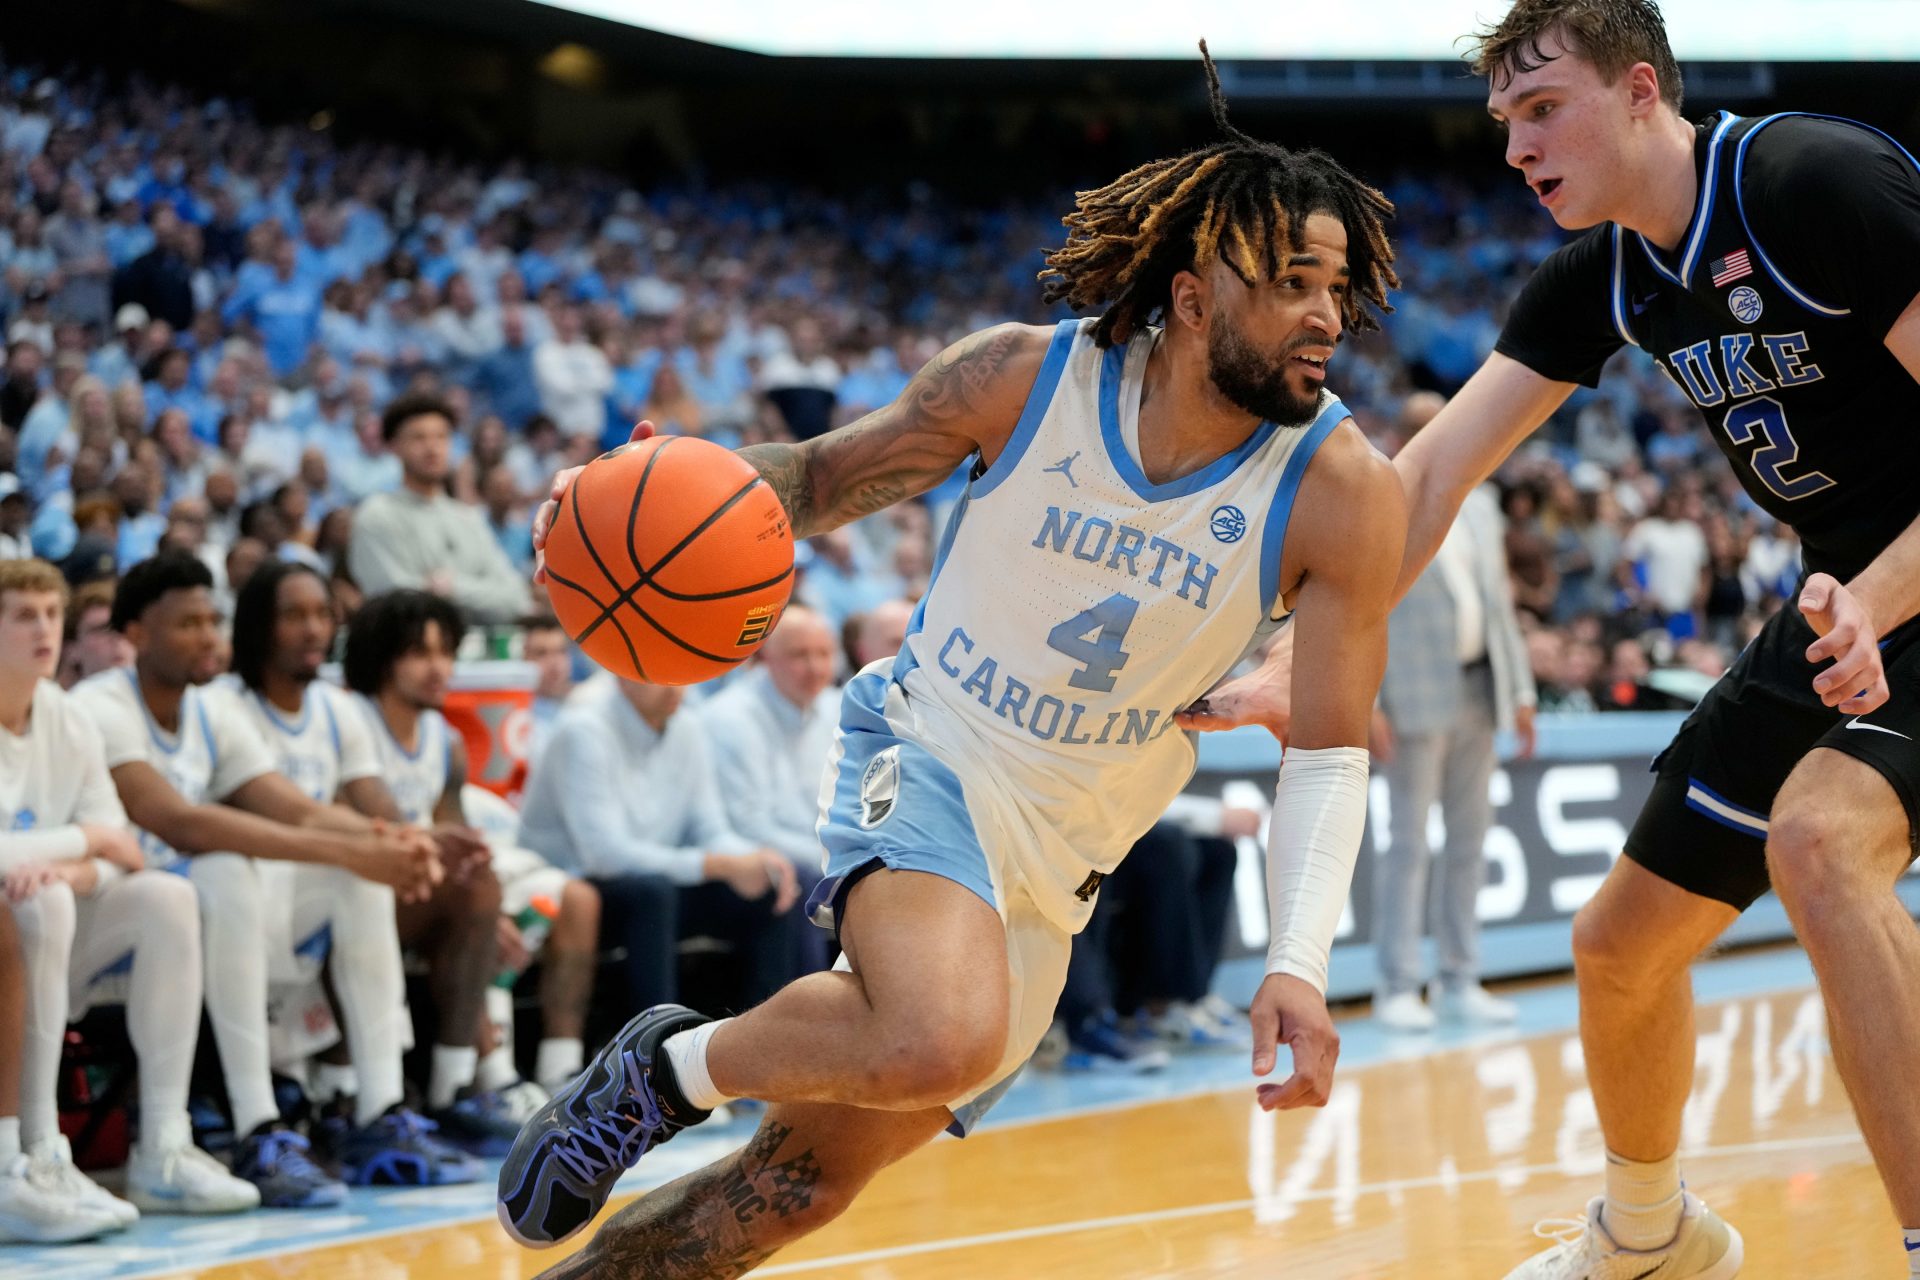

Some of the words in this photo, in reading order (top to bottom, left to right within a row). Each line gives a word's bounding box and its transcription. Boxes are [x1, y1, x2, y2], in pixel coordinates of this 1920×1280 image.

[1655, 330, 1825, 408] UKE
[1722, 394, 1838, 502] 2
[1031, 505, 1219, 611] NORTH
[1046, 591, 1140, 693] 4
